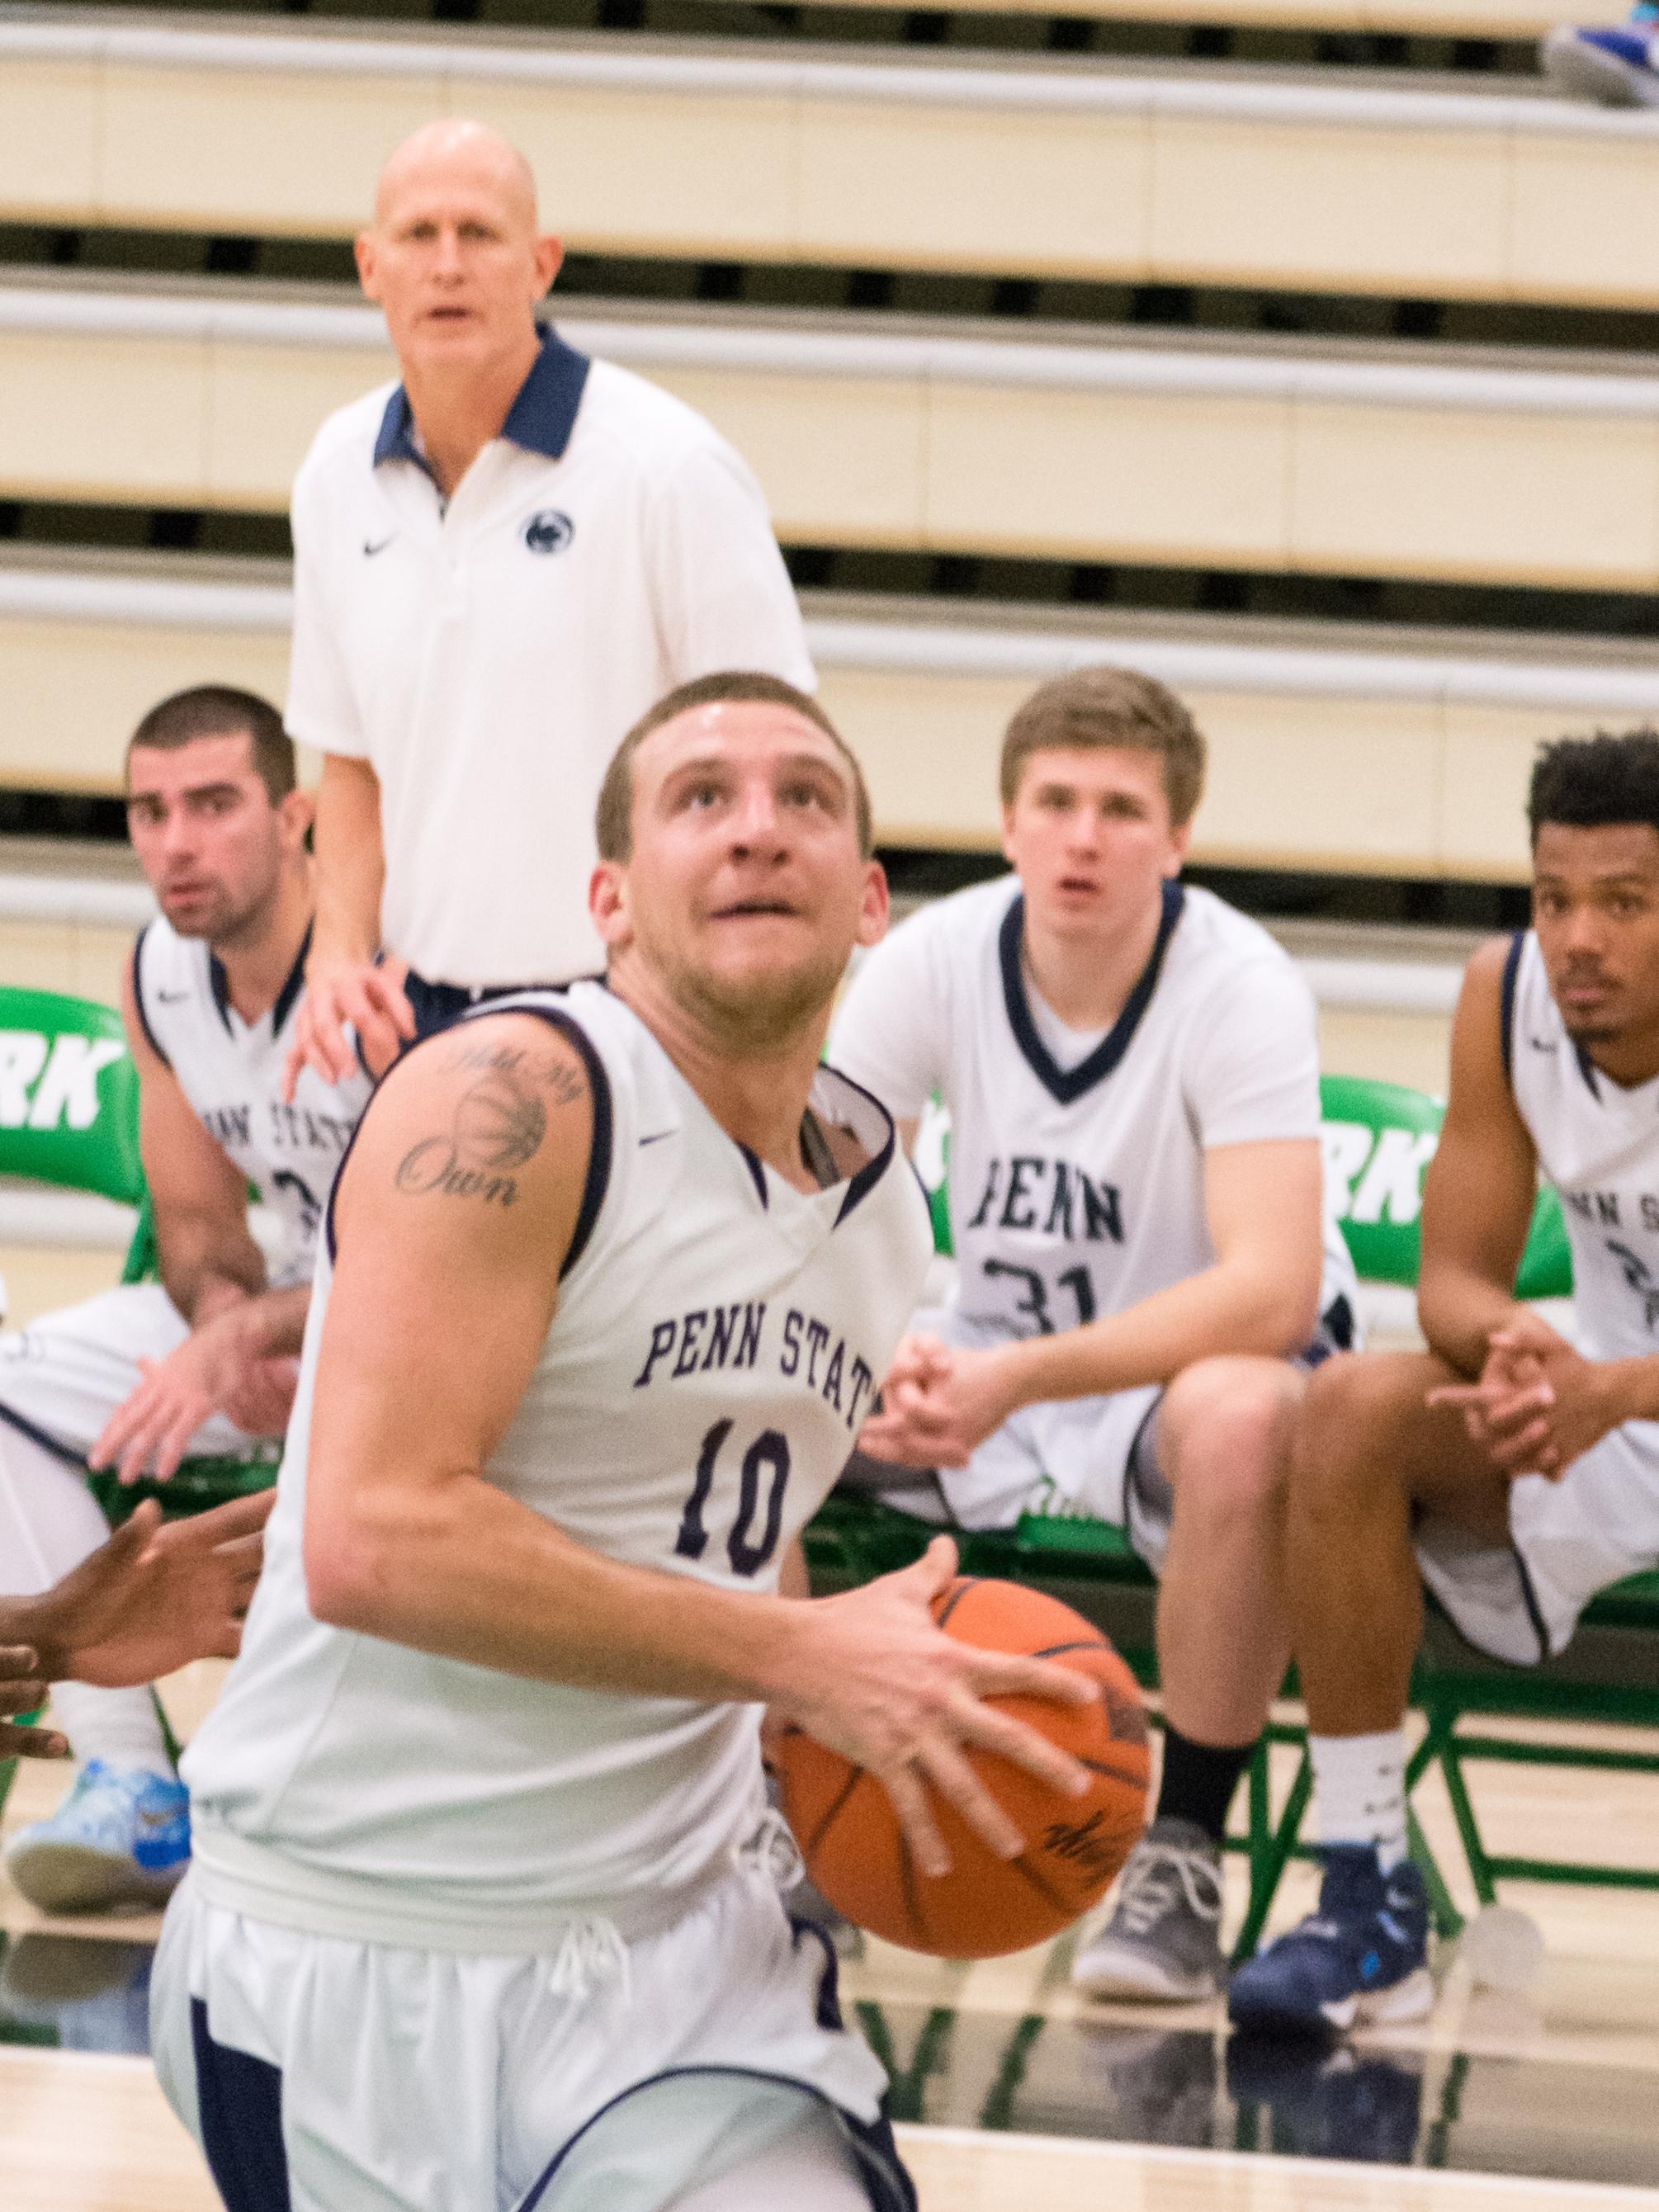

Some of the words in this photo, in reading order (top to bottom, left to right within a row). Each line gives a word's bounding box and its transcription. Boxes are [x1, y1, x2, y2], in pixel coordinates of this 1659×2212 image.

[982, 1255, 1097, 1334] 31
[633, 1301, 766, 1388] PENN
[674, 1416, 791, 1578] 10
